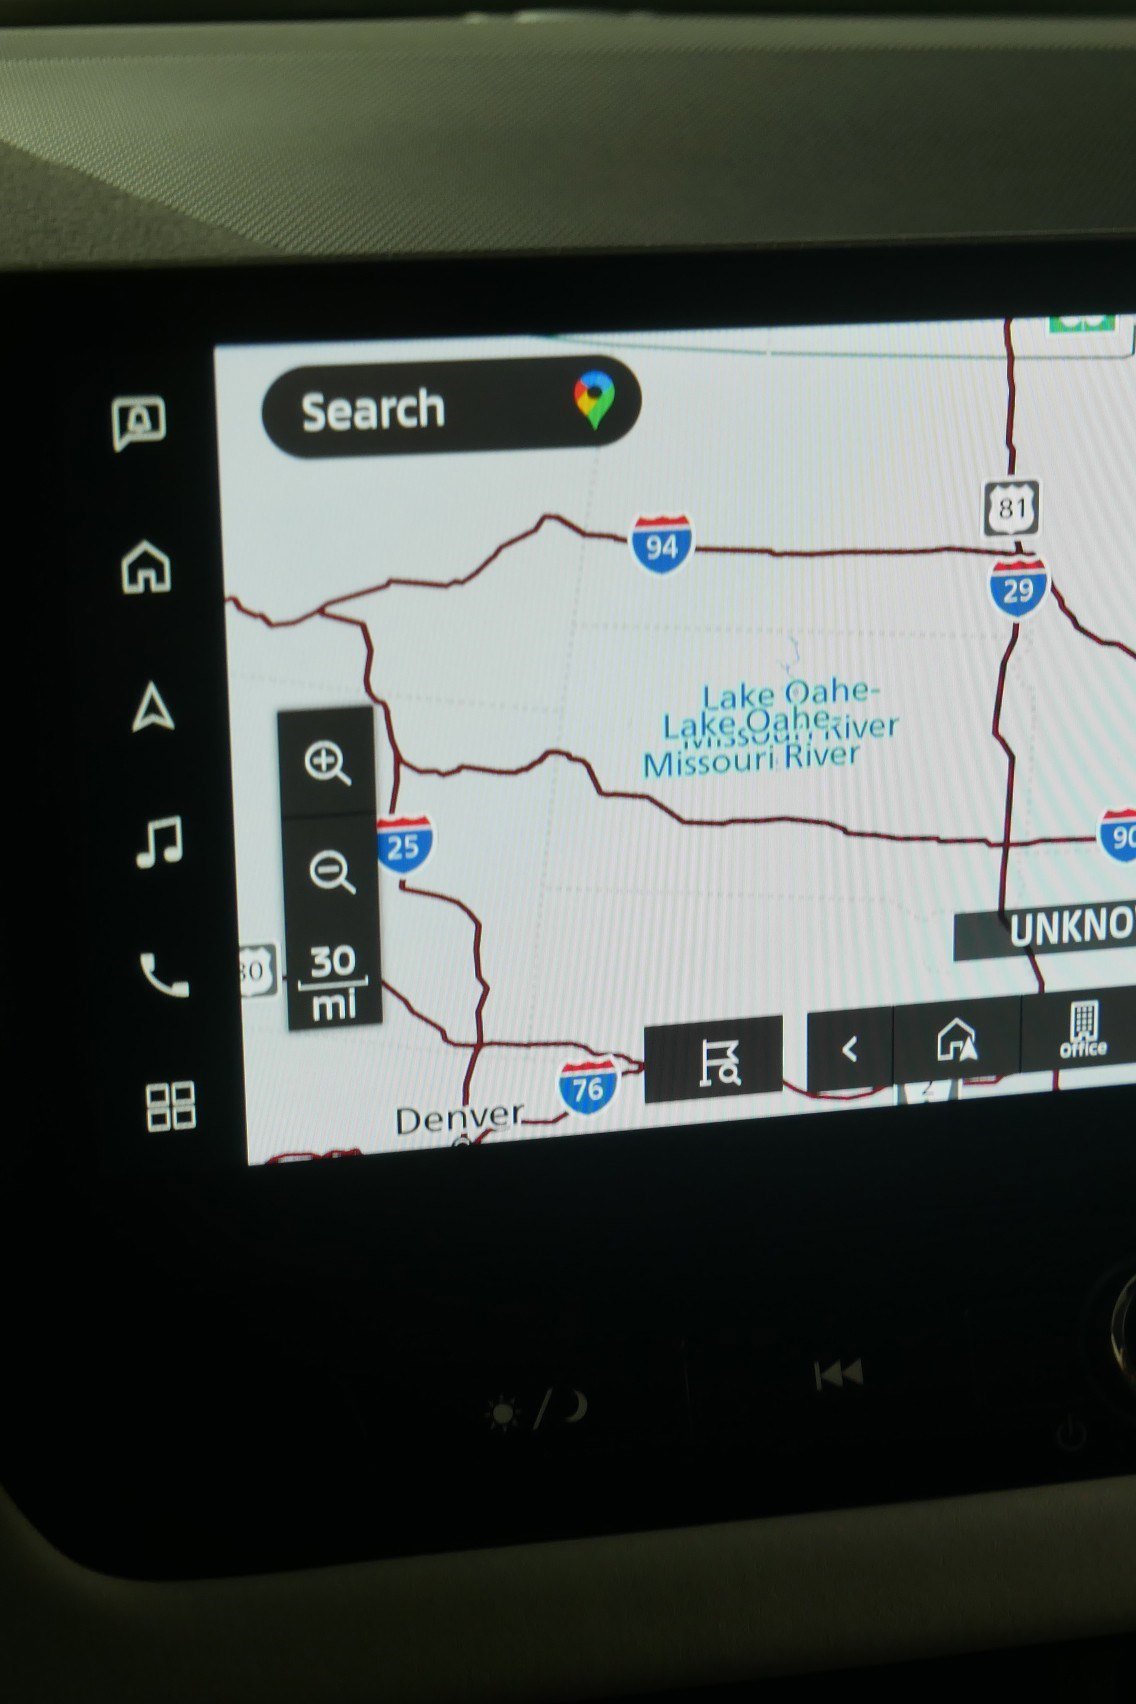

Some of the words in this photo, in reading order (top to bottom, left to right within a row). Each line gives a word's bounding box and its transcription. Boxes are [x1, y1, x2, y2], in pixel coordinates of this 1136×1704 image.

[302, 387, 445, 433] Search
[999, 498, 1027, 520] 81
[645, 535, 679, 560] 94
[1004, 579, 1034, 603] 29
[704, 682, 775, 710] Lake
[785, 676, 880, 704] Oahe-
[664, 711, 736, 740] Lake
[643, 745, 774, 779] Missouri
[786, 743, 861, 769] River
[388, 836, 418, 858] 25
[311, 944, 356, 978] 30
[313, 987, 356, 1022] mi
[572, 1077, 603, 1101] 76
[396, 1103, 525, 1135] Denver
